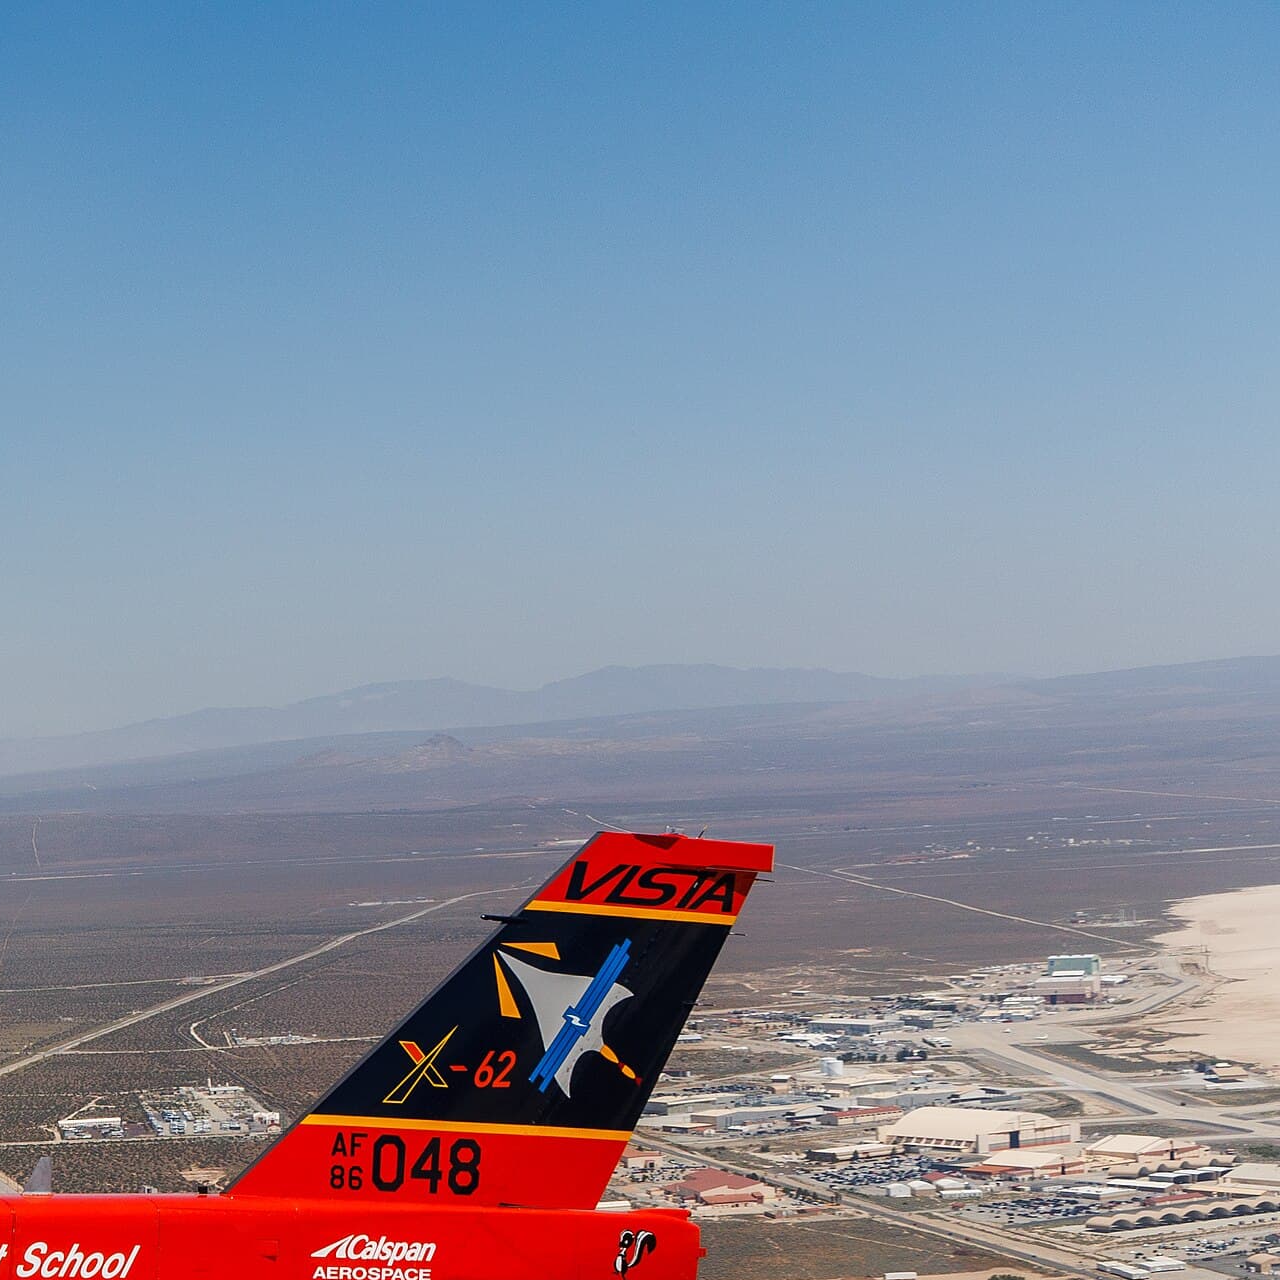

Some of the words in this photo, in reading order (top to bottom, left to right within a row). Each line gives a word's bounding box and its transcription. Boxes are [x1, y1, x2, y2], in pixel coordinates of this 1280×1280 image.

[565, 861, 737, 912] VISTA
[330, 1165, 364, 1190] 86
[331, 1132, 369, 1157] AF
[372, 1134, 482, 1195] 048
[15, 1241, 141, 1280] School
[347, 1234, 437, 1267] Calspan
